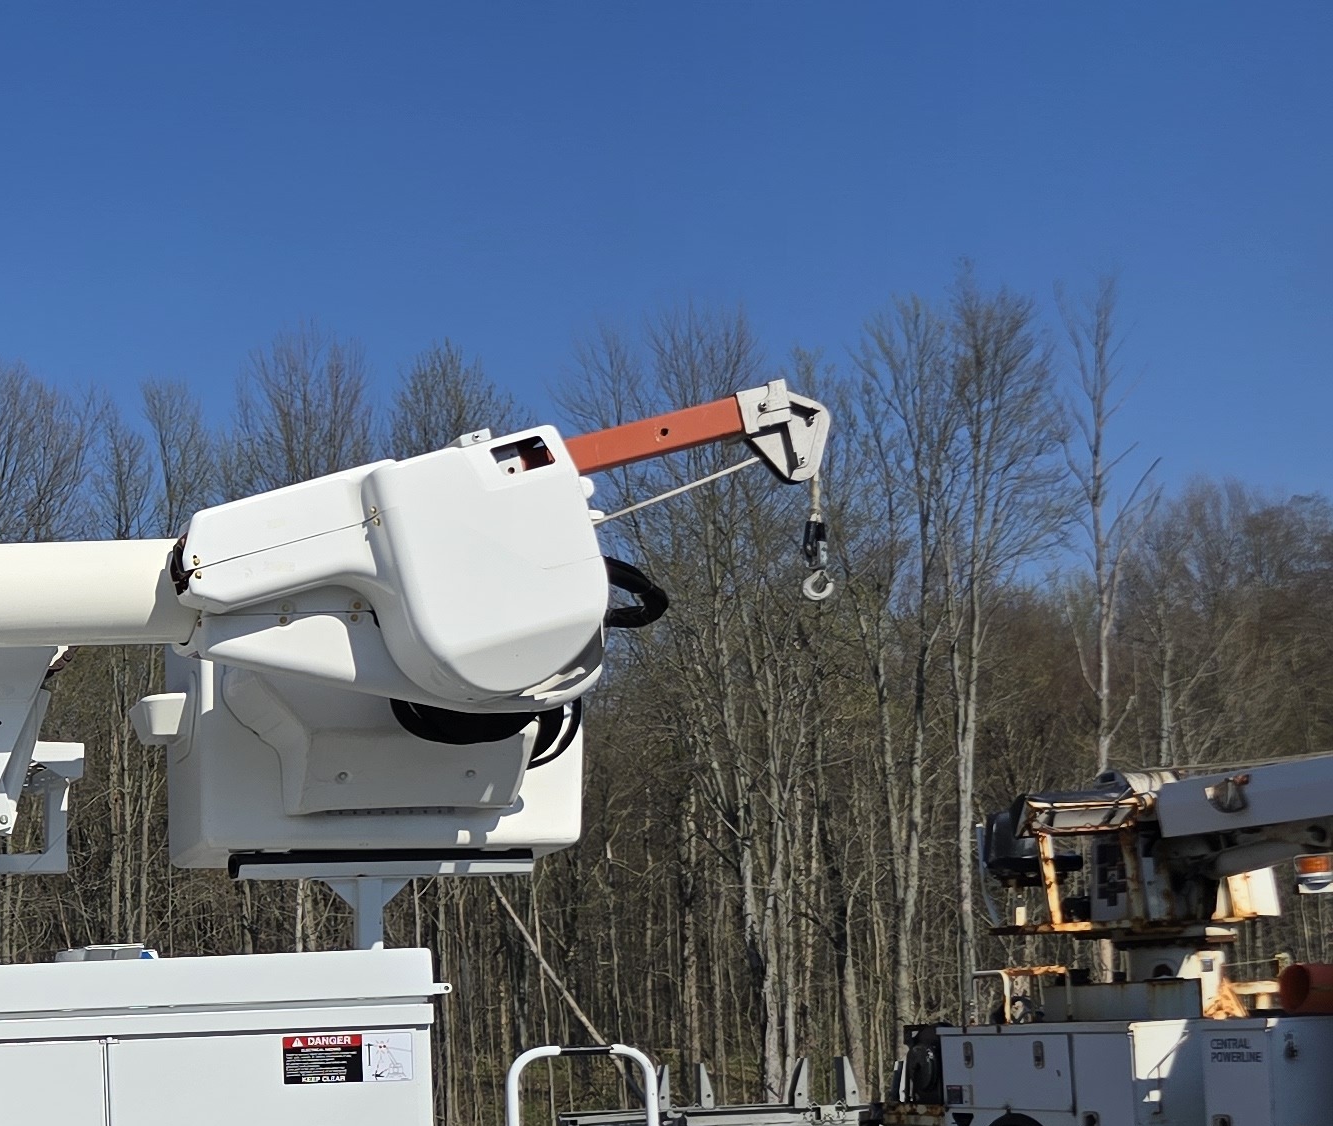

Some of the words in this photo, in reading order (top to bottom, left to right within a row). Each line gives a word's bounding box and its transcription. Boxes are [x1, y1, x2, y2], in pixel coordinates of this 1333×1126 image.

[307, 1035, 352, 1046] DANGER
[1210, 1038, 1251, 1050] CENTRAL
[1211, 1051, 1263, 1063] POWERLINE
